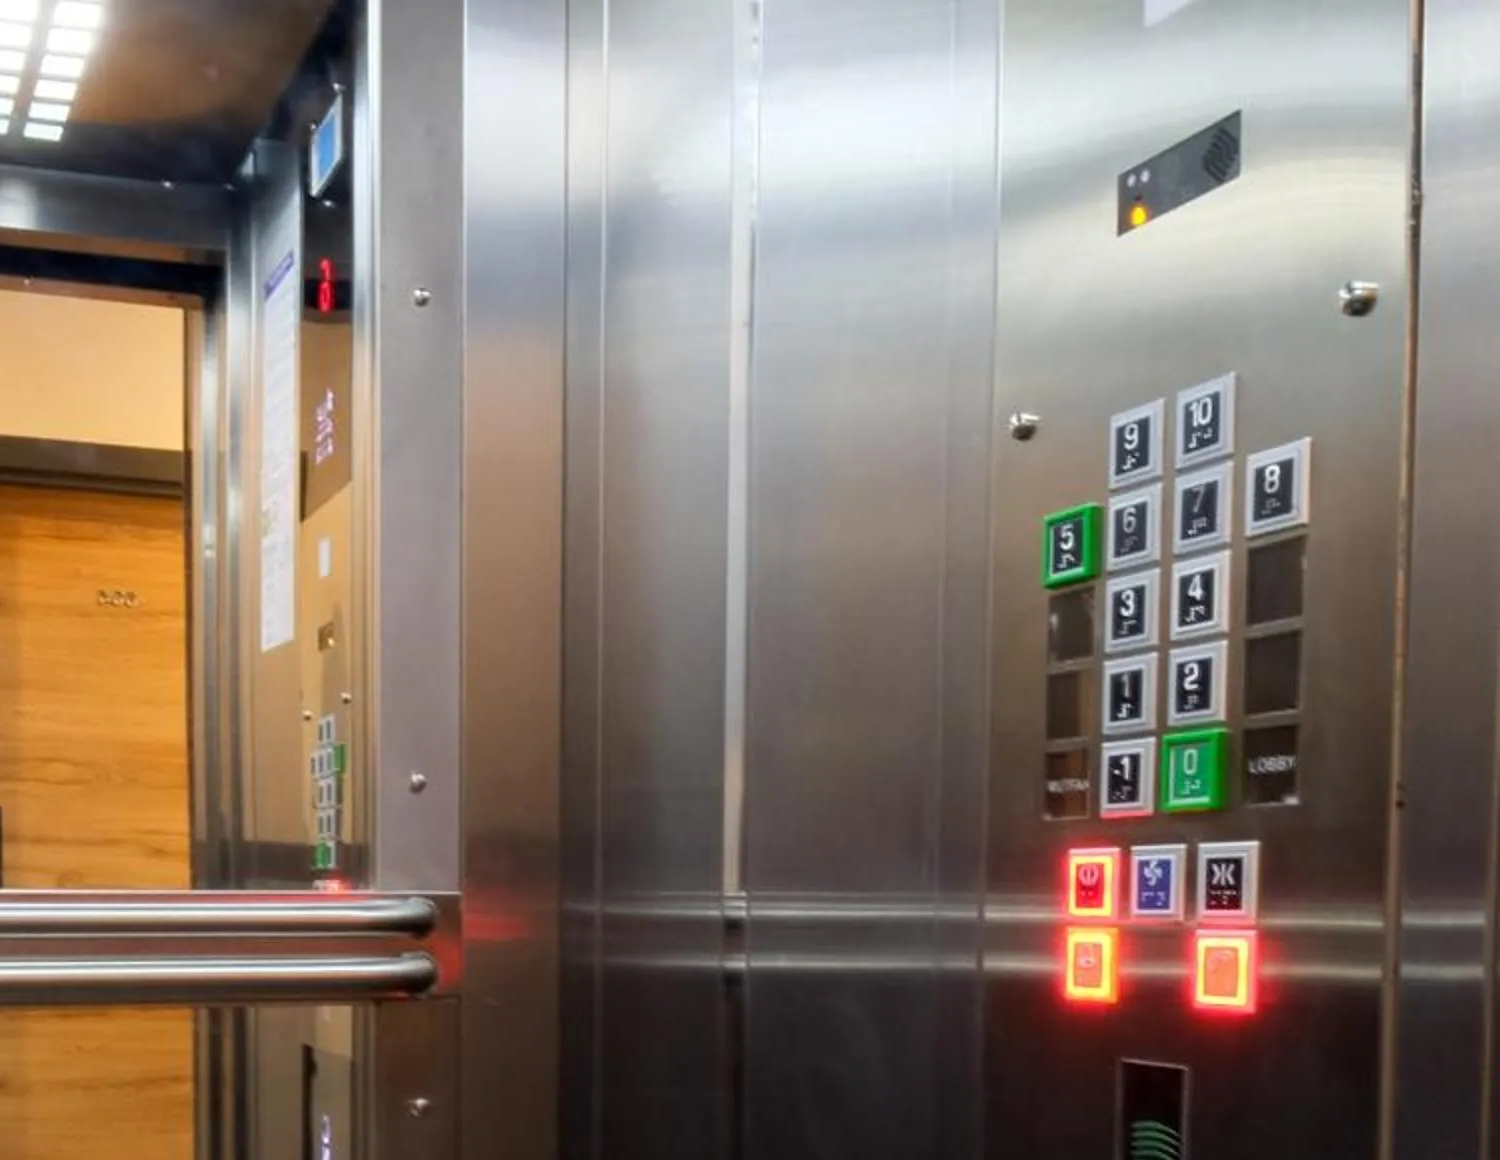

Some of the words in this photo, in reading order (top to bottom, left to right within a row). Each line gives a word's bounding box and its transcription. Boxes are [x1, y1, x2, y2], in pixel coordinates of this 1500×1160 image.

[1188, 397, 1213, 427] 10
[1123, 423, 1140, 450] 9
[1264, 464, 1281, 494] 8
[1192, 485, 1206, 513] 7
[1122, 507, 1137, 533] 6
[1060, 523, 1075, 550] 5
[1187, 573, 1204, 601] 4
[1120, 589, 1136, 617] 3
[1121, 673, 1130, 698] 1
[1183, 662, 1200, 691] 2
[1183, 748, 1198, 775] 0
